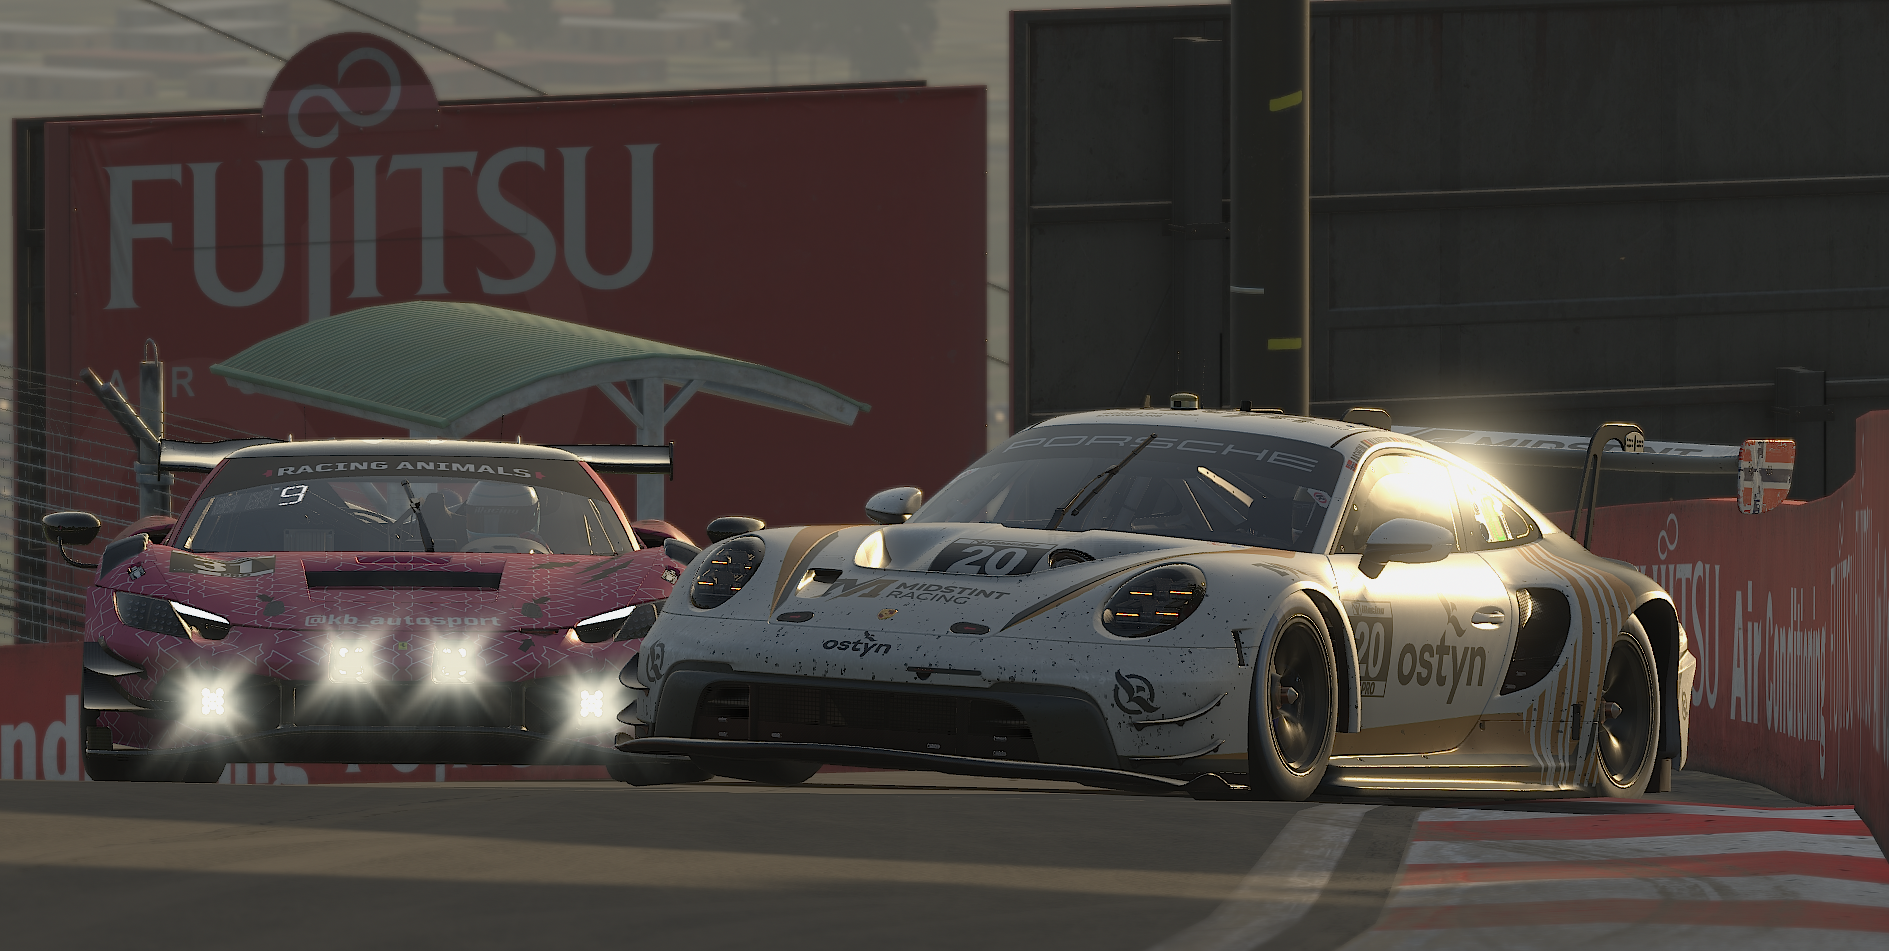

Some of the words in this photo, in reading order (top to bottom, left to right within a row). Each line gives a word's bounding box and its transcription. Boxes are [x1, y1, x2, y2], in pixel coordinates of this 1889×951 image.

[103, 143, 661, 323] FUJITSU
[107, 366, 195, 398] AR
[277, 462, 388, 476] RACING
[396, 461, 532, 478] ANIMALS
[1003, 435, 1319, 473] PORSCHE
[278, 484, 309, 507] 9
[946, 545, 1028, 576] 20
[886, 590, 971, 605] RACING
[895, 582, 1010, 600] MIDSTINT
[304, 614, 501, 628] @kb_autosport
[822, 636, 892, 657] ostyn
[1355, 621, 1385, 679] 20
[1397, 629, 1487, 705] ostyn
[1730, 580, 1762, 724] Air
[1765, 585, 1827, 780] Conditioning
